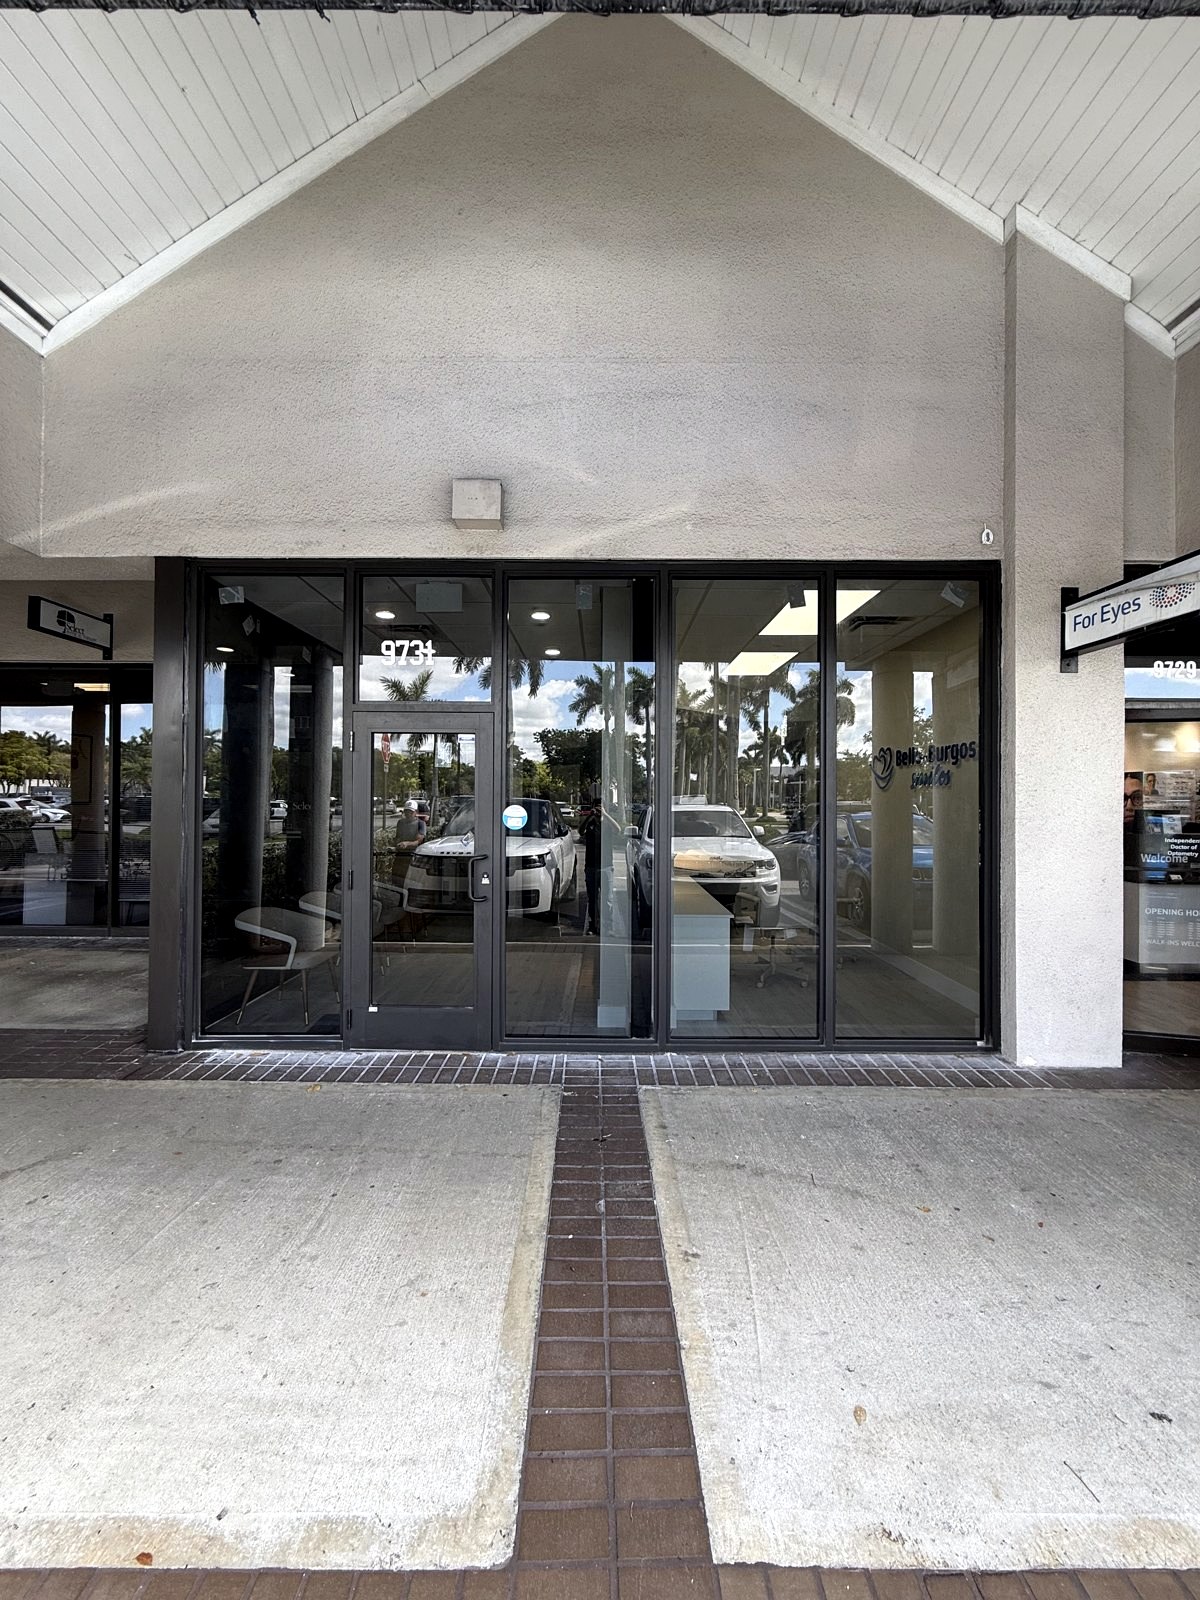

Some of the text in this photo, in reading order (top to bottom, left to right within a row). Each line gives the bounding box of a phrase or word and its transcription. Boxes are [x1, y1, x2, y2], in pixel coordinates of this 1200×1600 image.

[1073, 597, 1141, 632] For Eyes
[381, 639, 436, 665] 9731
[1153, 660, 1197, 679] 9729
[1140, 852, 1189, 863] Welcome
[1167, 850, 1199, 858] Optometry
[1144, 907, 1200, 917] OPENING HO
